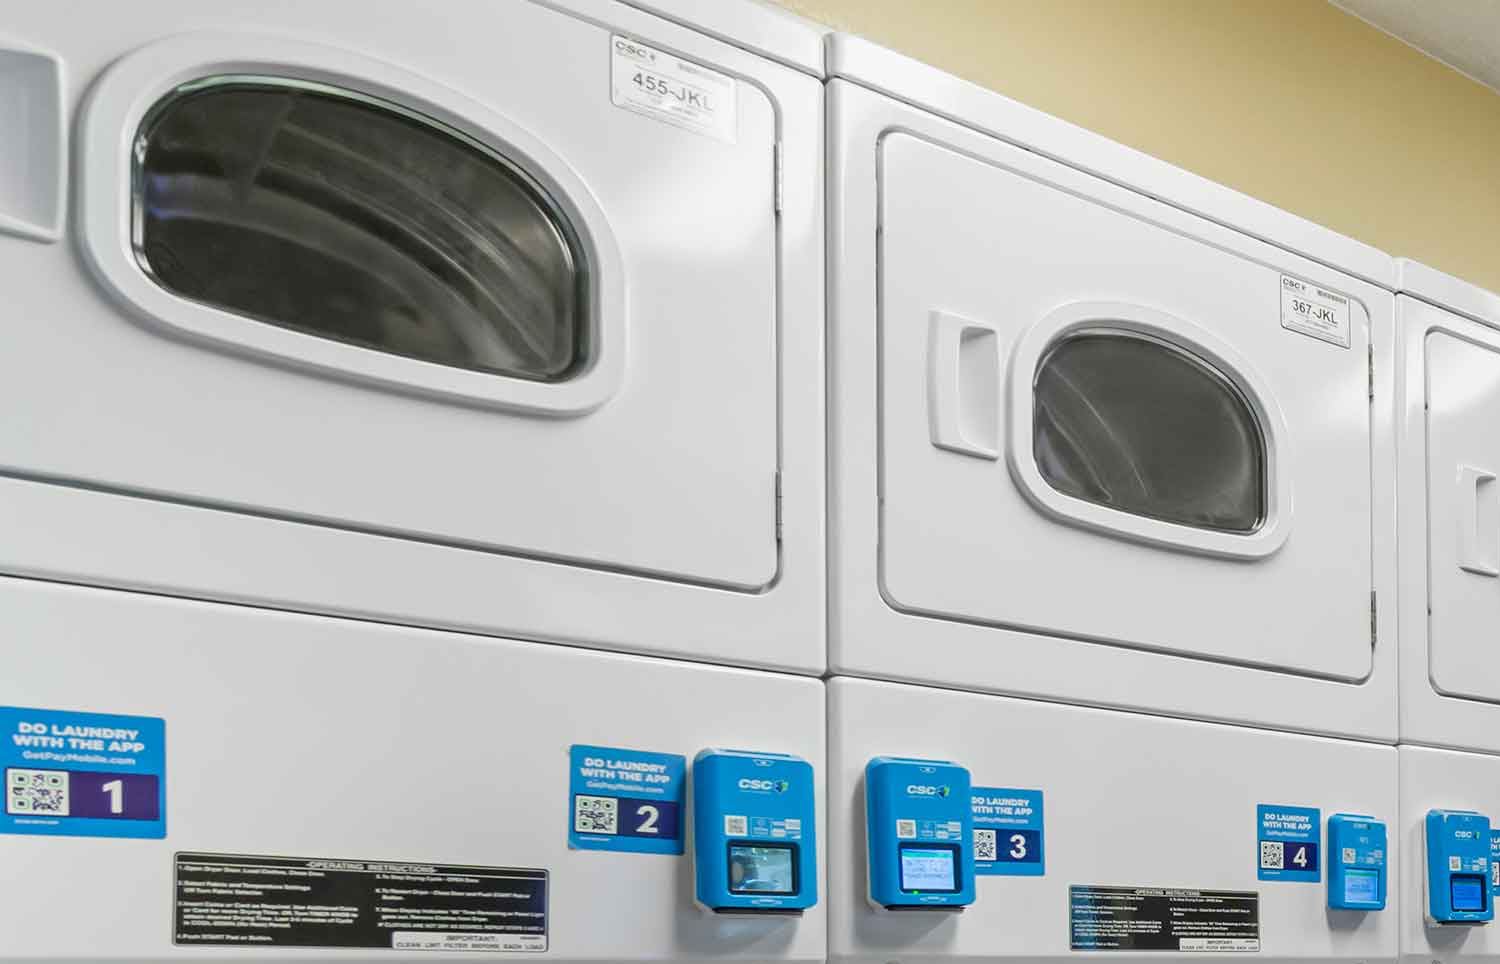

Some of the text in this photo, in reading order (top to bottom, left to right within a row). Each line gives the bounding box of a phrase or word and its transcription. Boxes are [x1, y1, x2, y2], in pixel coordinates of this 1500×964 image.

[632, 72, 713, 111] 455-JKL
[18, 721, 139, 741] DO LAUNDRY
[13, 734, 145, 753] WITH THE APP
[584, 757, 666, 773] DO LAUNDRY
[580, 767, 671, 784] WITH THE APP
[738, 778, 773, 791] CSC
[102, 780, 123, 814] 1
[907, 785, 936, 796] CSC
[986, 797, 1030, 807] LAUNDRY
[995, 806, 1012, 815] THE
[1014, 807, 1032, 816] APP
[636, 805, 660, 833] 2
[1263, 821, 1282, 829] WITH
[1298, 822, 1312, 831] APP
[1009, 834, 1026, 859] 3
[1293, 846, 1308, 867] 4
